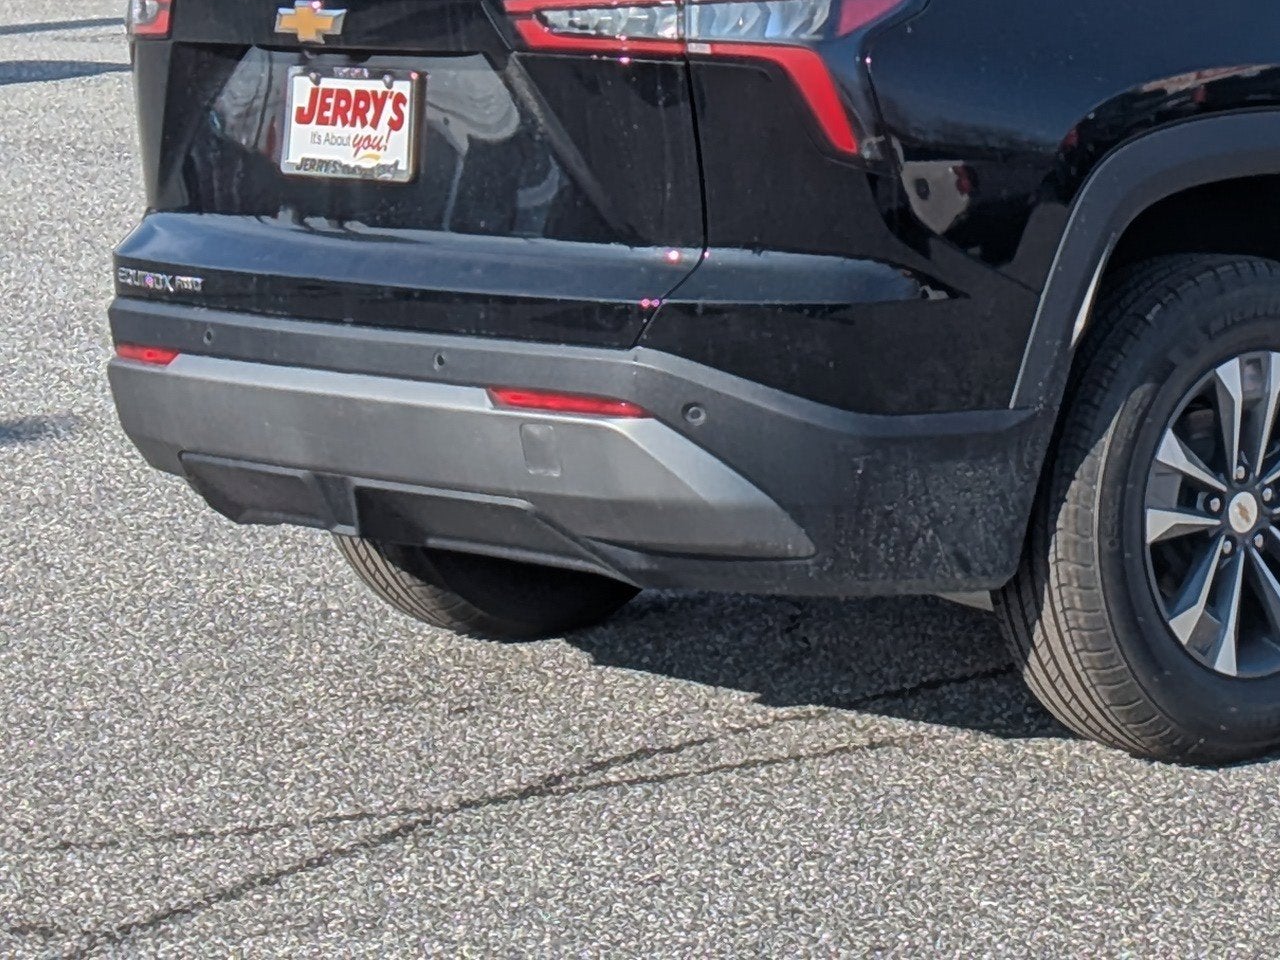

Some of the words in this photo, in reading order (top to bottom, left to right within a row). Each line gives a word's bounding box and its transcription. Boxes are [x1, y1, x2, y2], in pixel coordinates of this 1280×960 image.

[294, 87, 408, 132] JERRY'S
[310, 130, 322, 145] It's
[323, 132, 351, 147] About
[351, 128, 393, 158] you!
